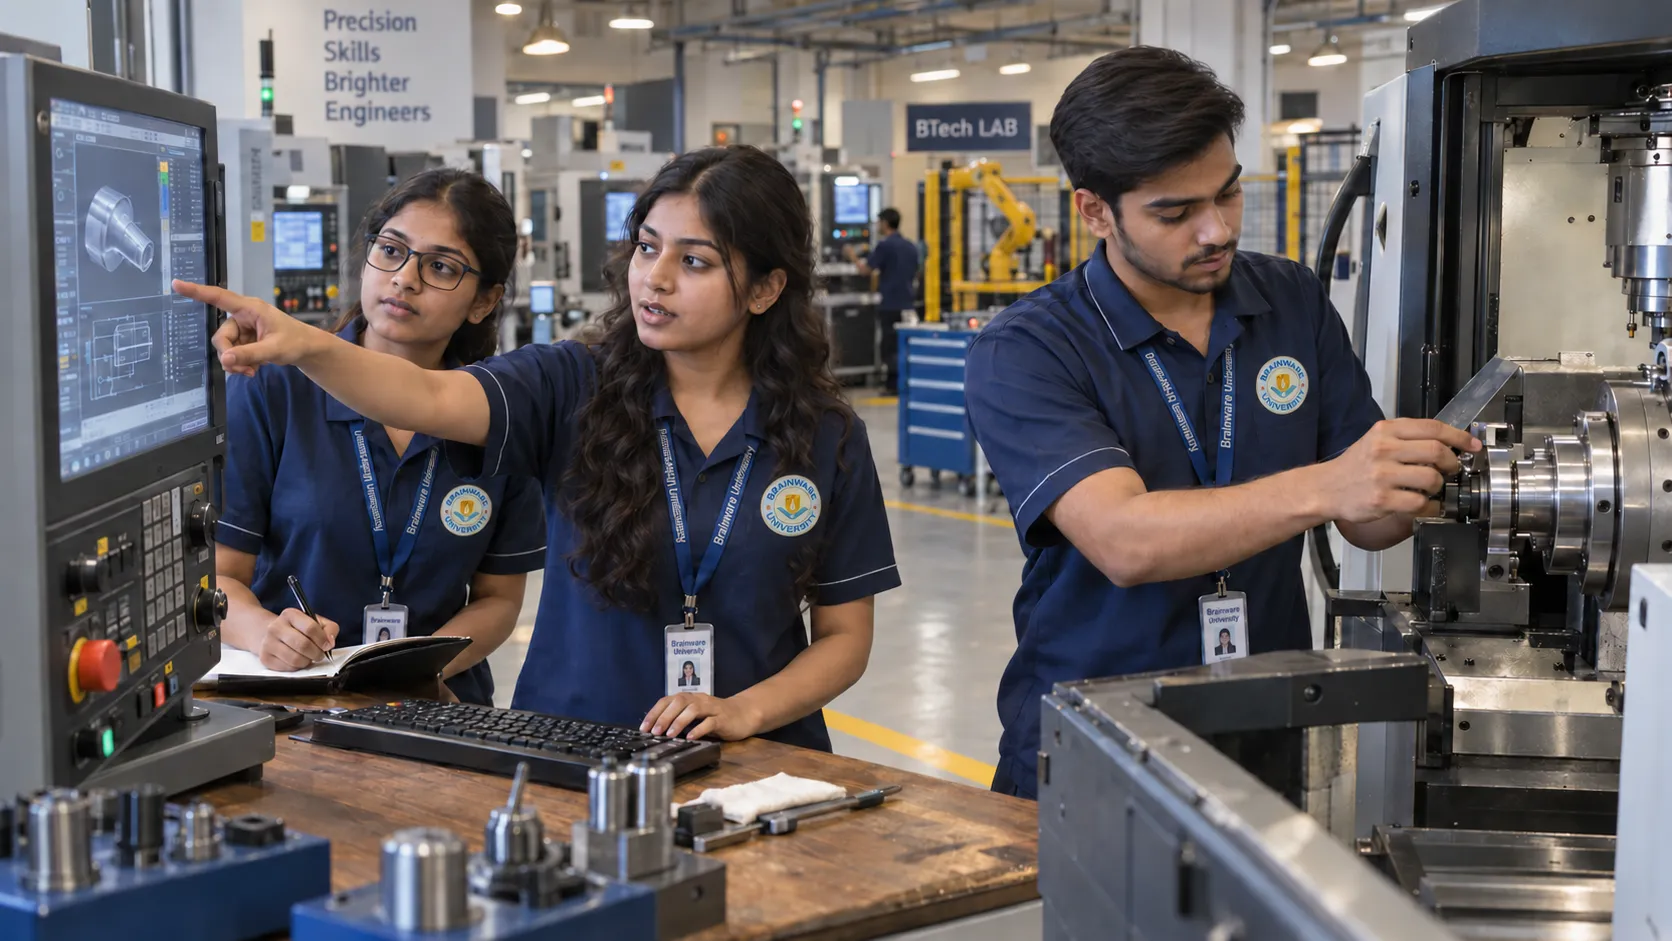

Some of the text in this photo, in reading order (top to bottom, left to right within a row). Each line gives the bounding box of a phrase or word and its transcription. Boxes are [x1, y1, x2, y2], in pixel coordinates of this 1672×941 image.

[324, 9, 417, 31] Precision
[324, 40, 381, 62] Skills
[325, 70, 410, 98] Brighter
[325, 100, 431, 127] Engineers
[916, 118, 1018, 138] BTech LAB
